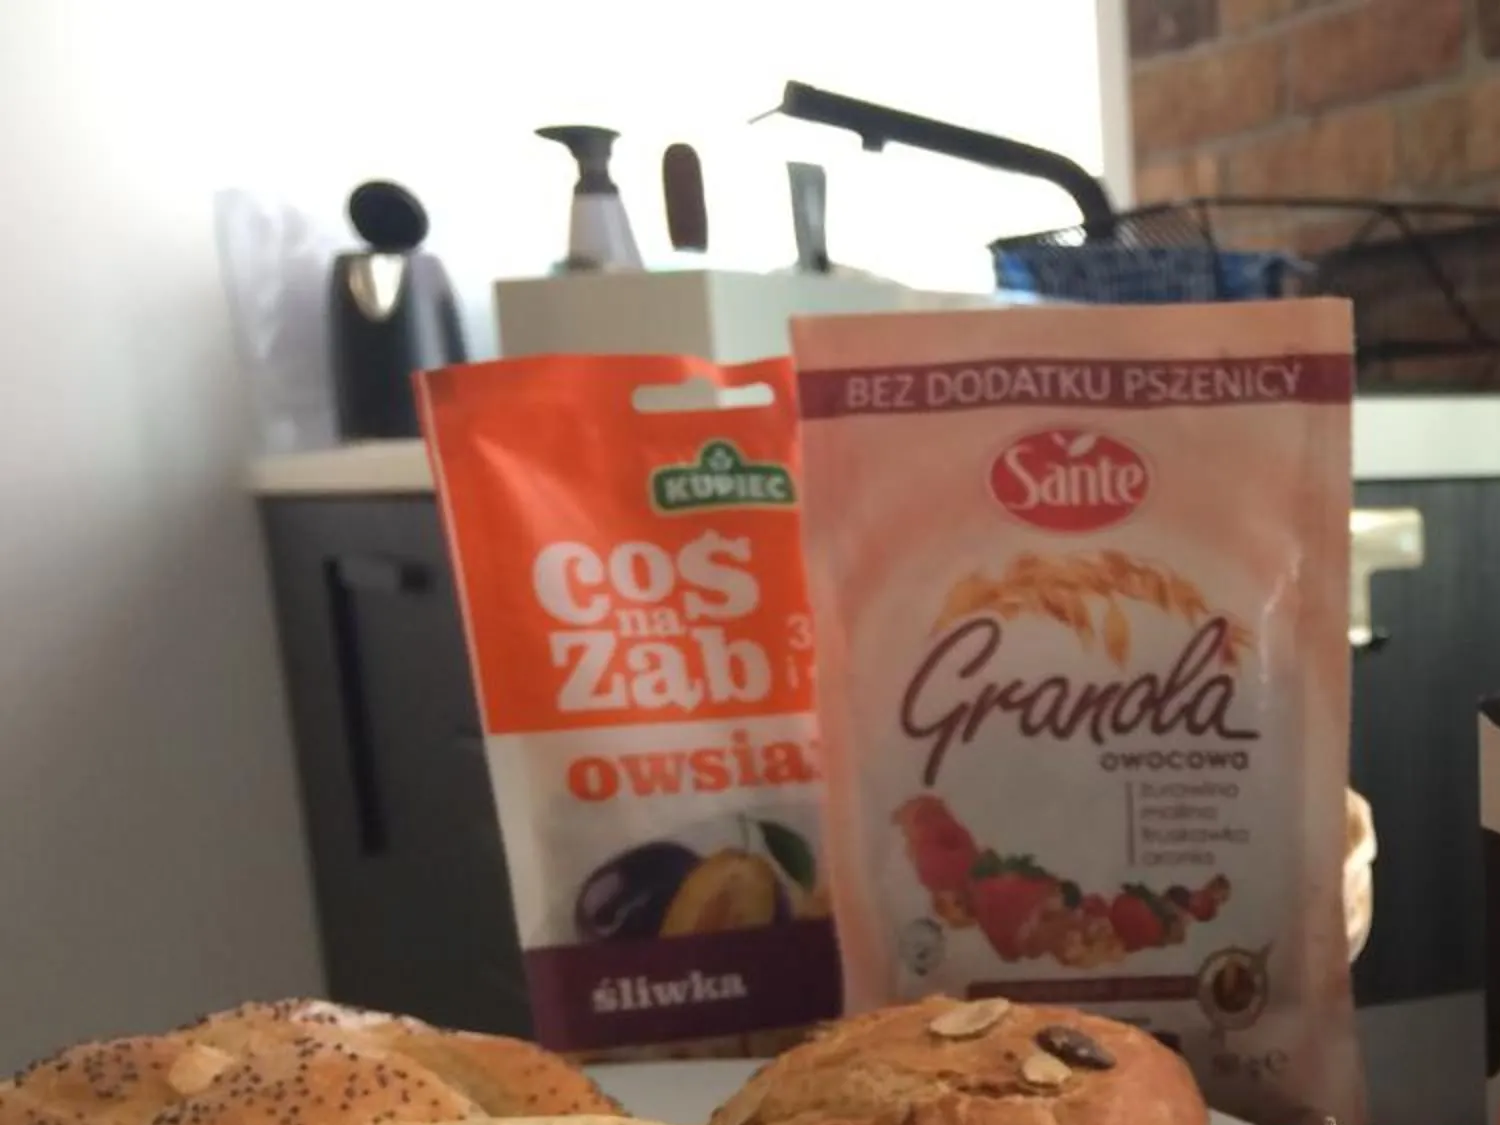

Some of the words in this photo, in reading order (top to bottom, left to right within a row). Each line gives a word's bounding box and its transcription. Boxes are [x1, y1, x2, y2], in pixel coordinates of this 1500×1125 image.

[847, 374, 916, 409] BEZ
[926, 364, 1112, 408] DODATKU
[1124, 363, 1303, 402] PSZENICY
[664, 474, 788, 504] KUPIEC
[1005, 444, 1145, 511] Sante
[617, 608, 687, 638] na
[901, 615, 1262, 788] Granola
[566, 728, 822, 803] owsia
[1100, 749, 1249, 773] owocowa
[591, 970, 748, 1014] śliwka
